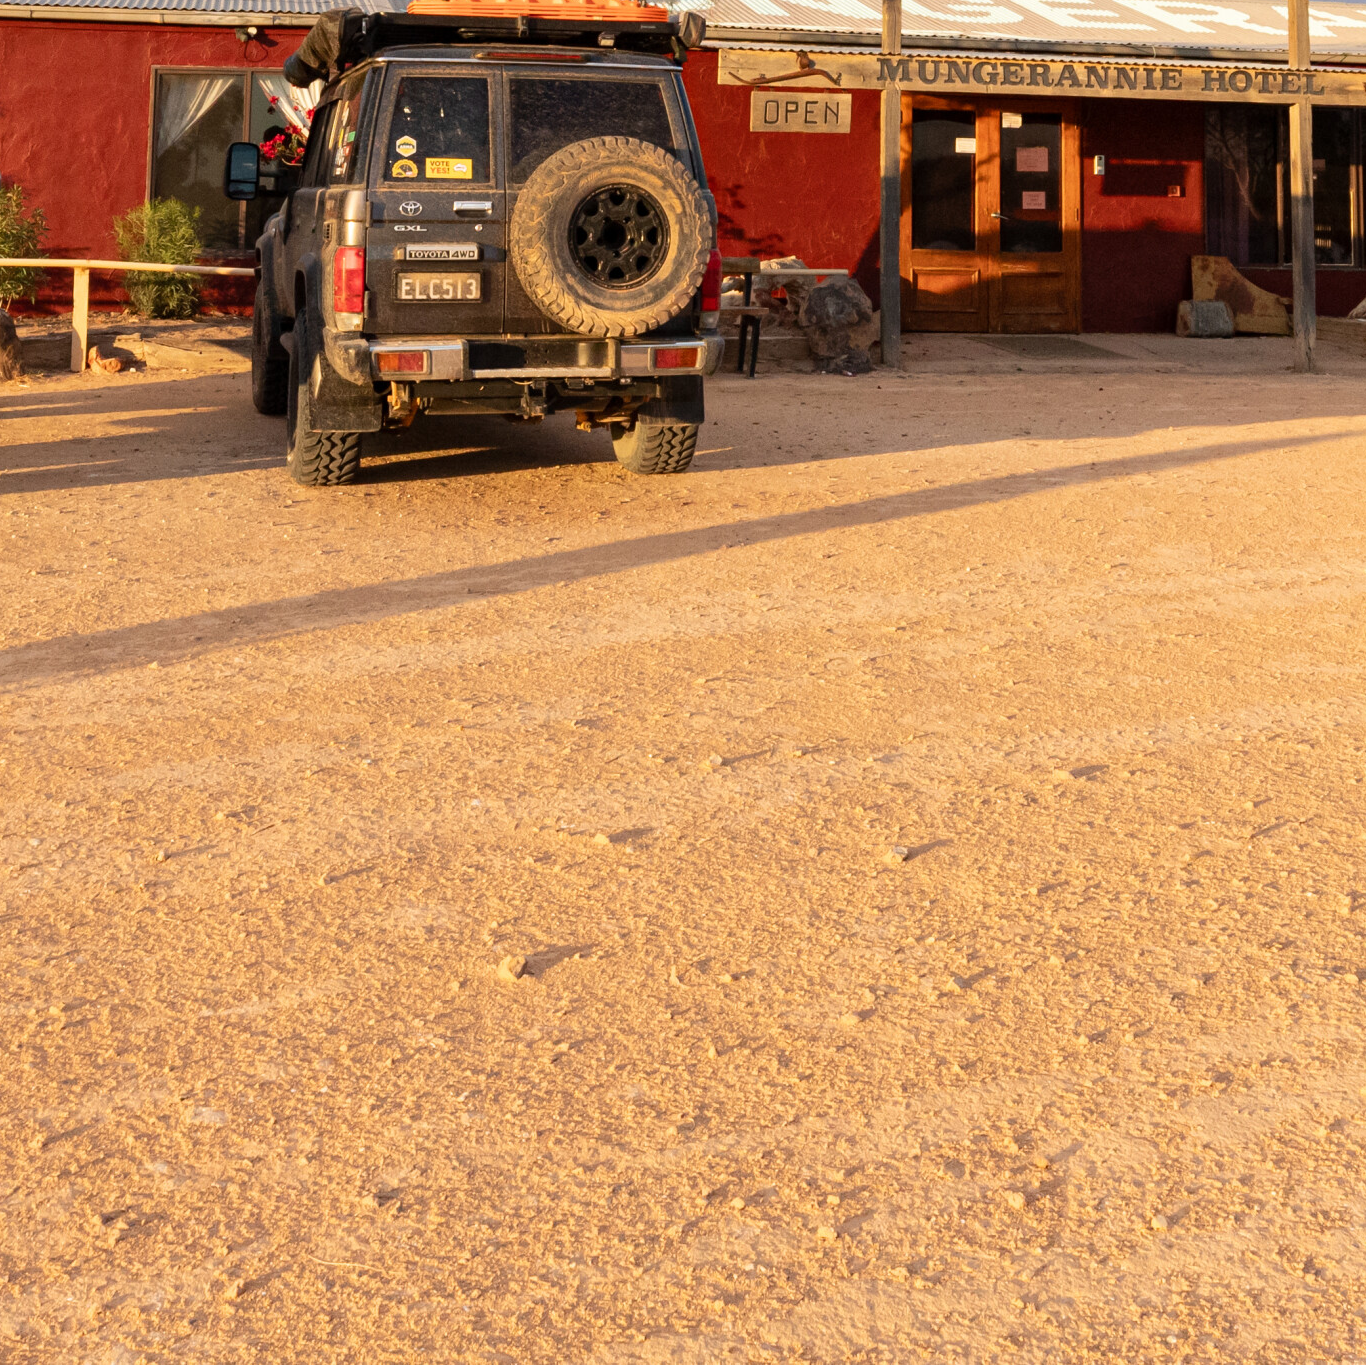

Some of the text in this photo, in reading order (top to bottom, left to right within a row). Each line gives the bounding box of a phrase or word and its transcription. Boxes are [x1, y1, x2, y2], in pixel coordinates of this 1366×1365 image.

[876, 57, 1325, 95] MUNGERANNIE HOTEL
[763, 100, 840, 124] OPEN
[430, 167, 450, 175] YES!
[410, 250, 475, 258] TOYOTA 4WD
[401, 279, 477, 300] ELC513
